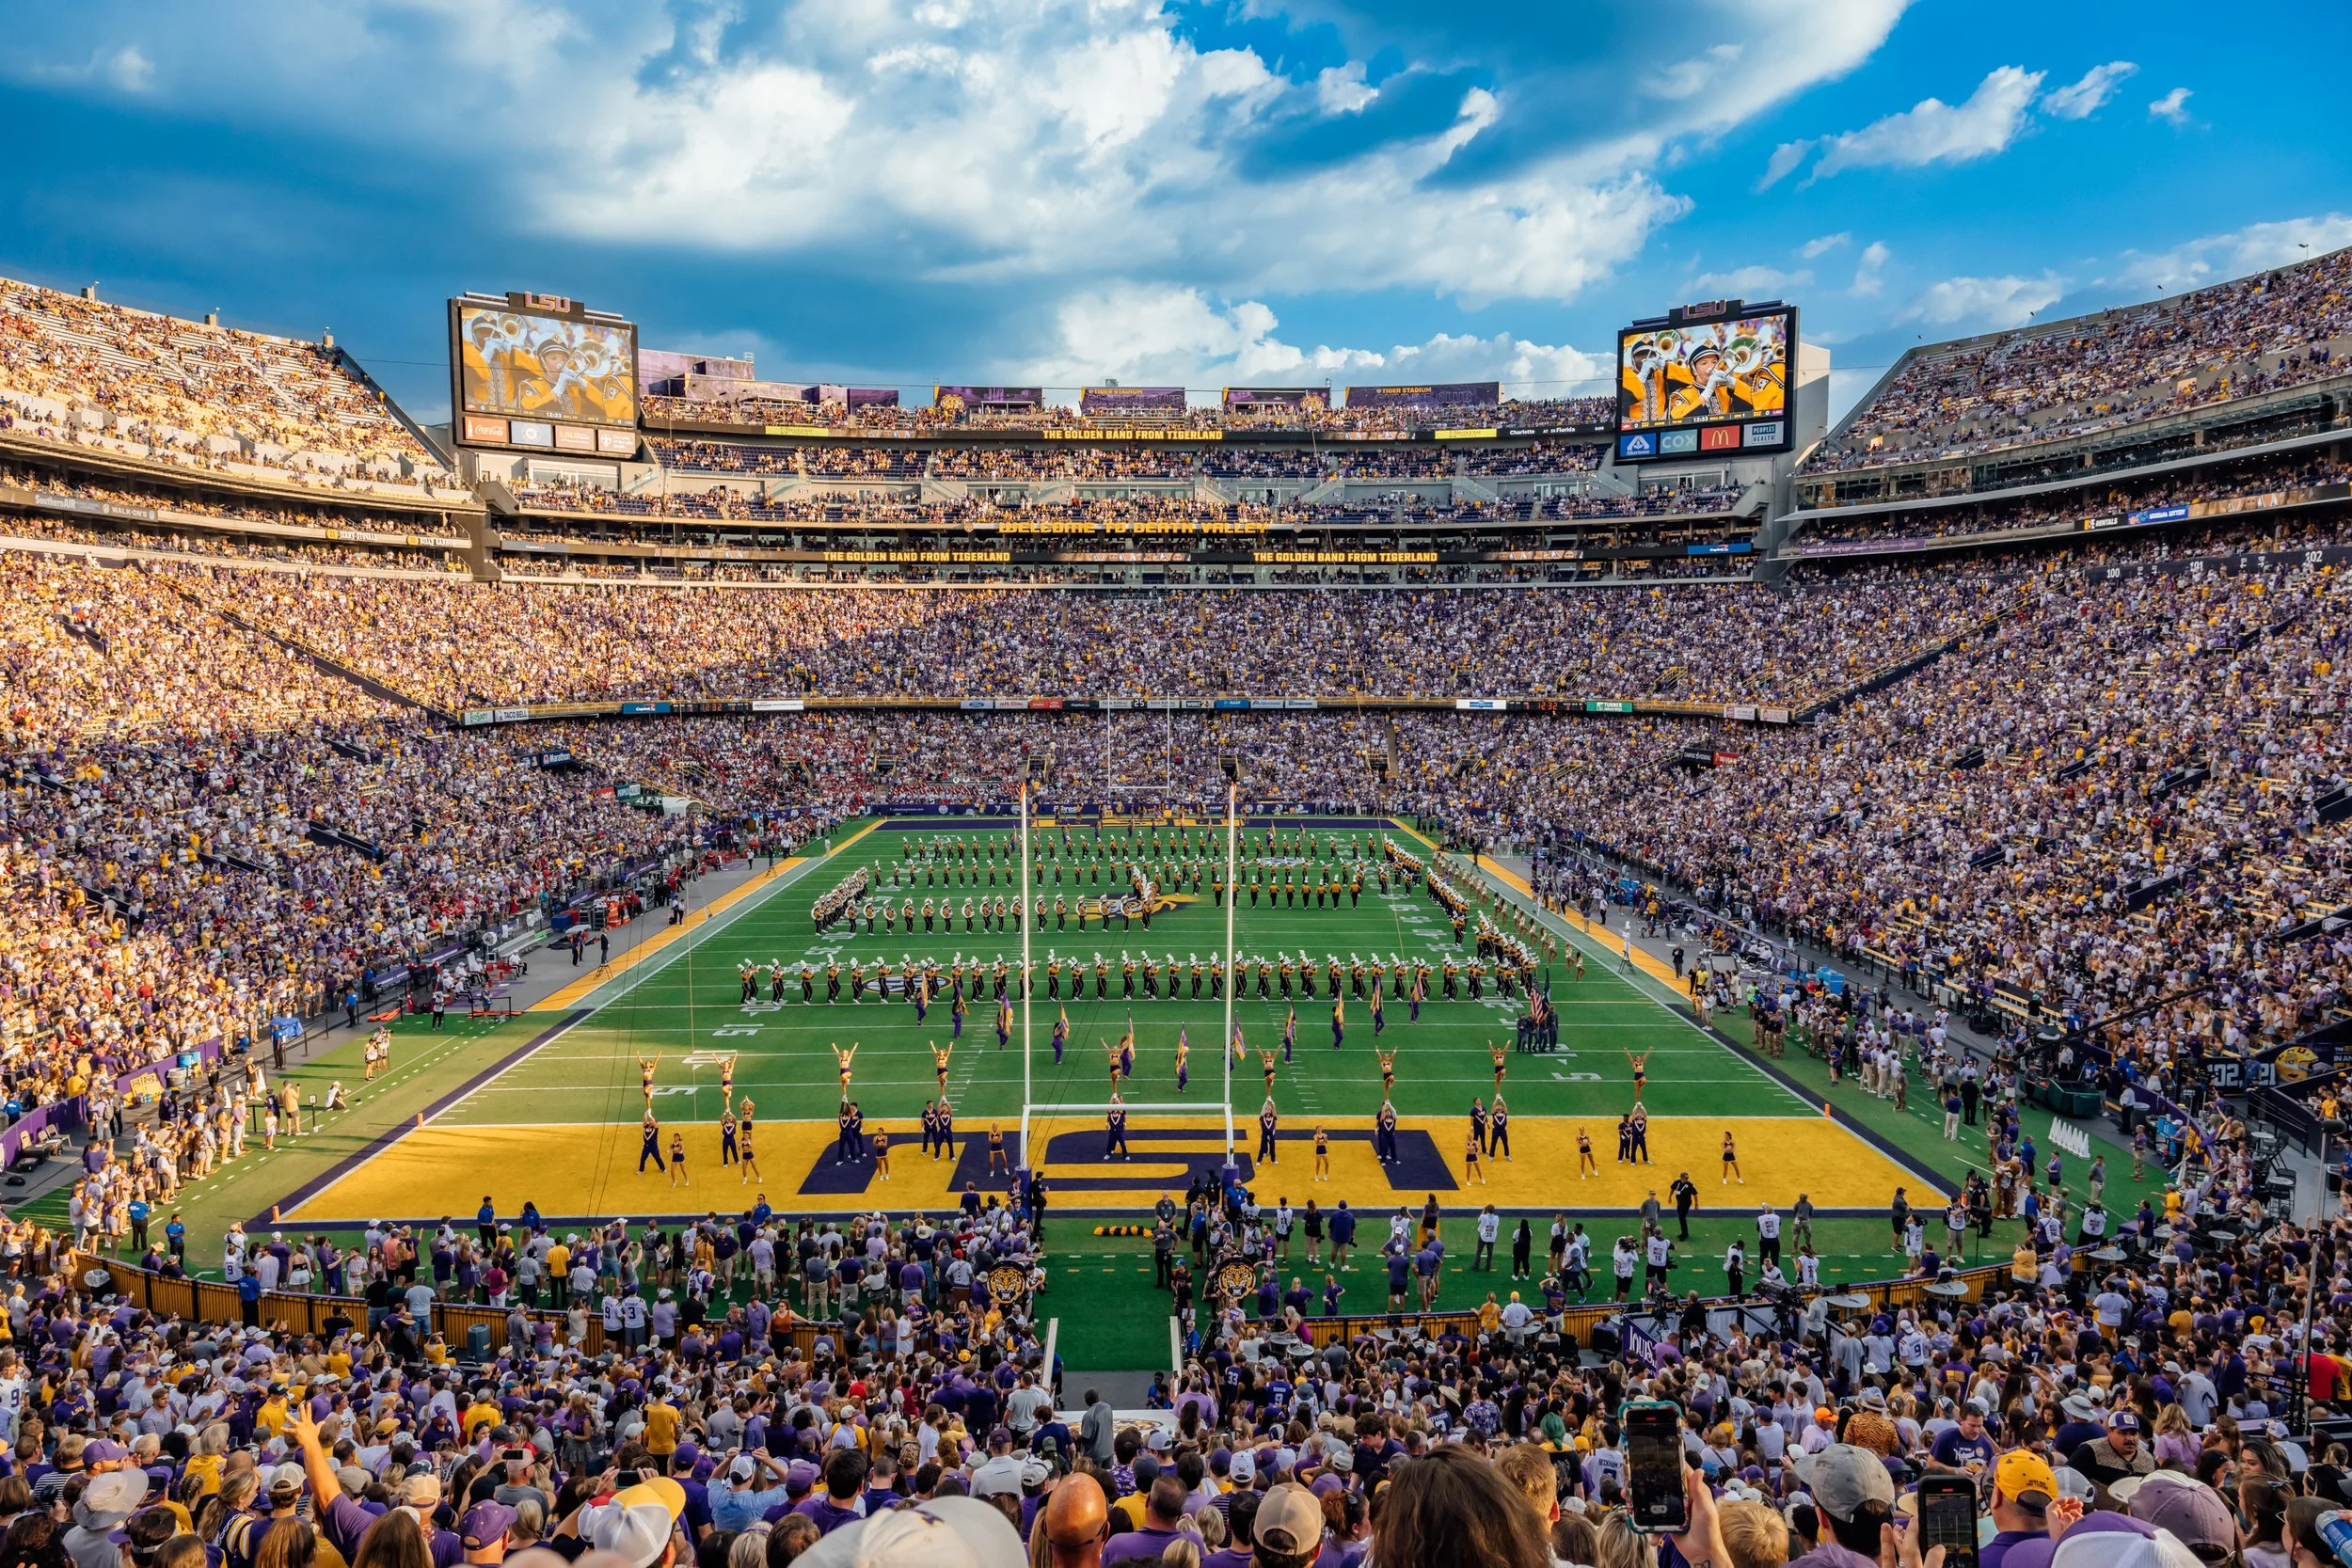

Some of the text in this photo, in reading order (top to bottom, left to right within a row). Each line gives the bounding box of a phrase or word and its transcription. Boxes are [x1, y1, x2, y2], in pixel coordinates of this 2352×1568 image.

[524, 291, 570, 313] LSU
[1682, 299, 1727, 320] LSU
[1148, 395, 1183, 406] CLUB
[1437, 391, 1473, 404] CLUB
[1043, 430, 1223, 440] THE GOLDEN BAND FROM TIGERLAND
[111, 506, 148, 517] WALK-ON'S
[999, 523, 1269, 533] WELCOME TO DEATH VALLEY
[2095, 518, 2117, 527] RENTALS
[823, 552, 1010, 562] THE GOLDEN BAND FROM TIGERLAND
[1254, 552, 1438, 562] THE GOLDEN BAND FROM TIGERLAND
[2305, 551, 2323, 562] 102
[2106, 568, 2120, 578] 100
[1134, 699, 1144, 707] 25
[549, 754, 570, 763] Marathon
[712, 1024, 764, 1036] 15
[650, 1087, 699, 1095] 5
[228, 1265, 233, 1275] 9
[605, 1307, 611, 1318] 9
[628, 1307, 636, 1320] 3
[1915, 1345, 1921, 1357] 9
[2031, 1352, 2038, 1365] 7
[1227, 1372, 1238, 1386] 33
[11, 1389, 20, 1408] 9
[920, 1387, 925, 1400] 1
[1275, 1394, 1283, 1406] 9
[72, 1405, 84, 1416] LSU
[1598, 1459, 1618, 1468] BECKHAM
